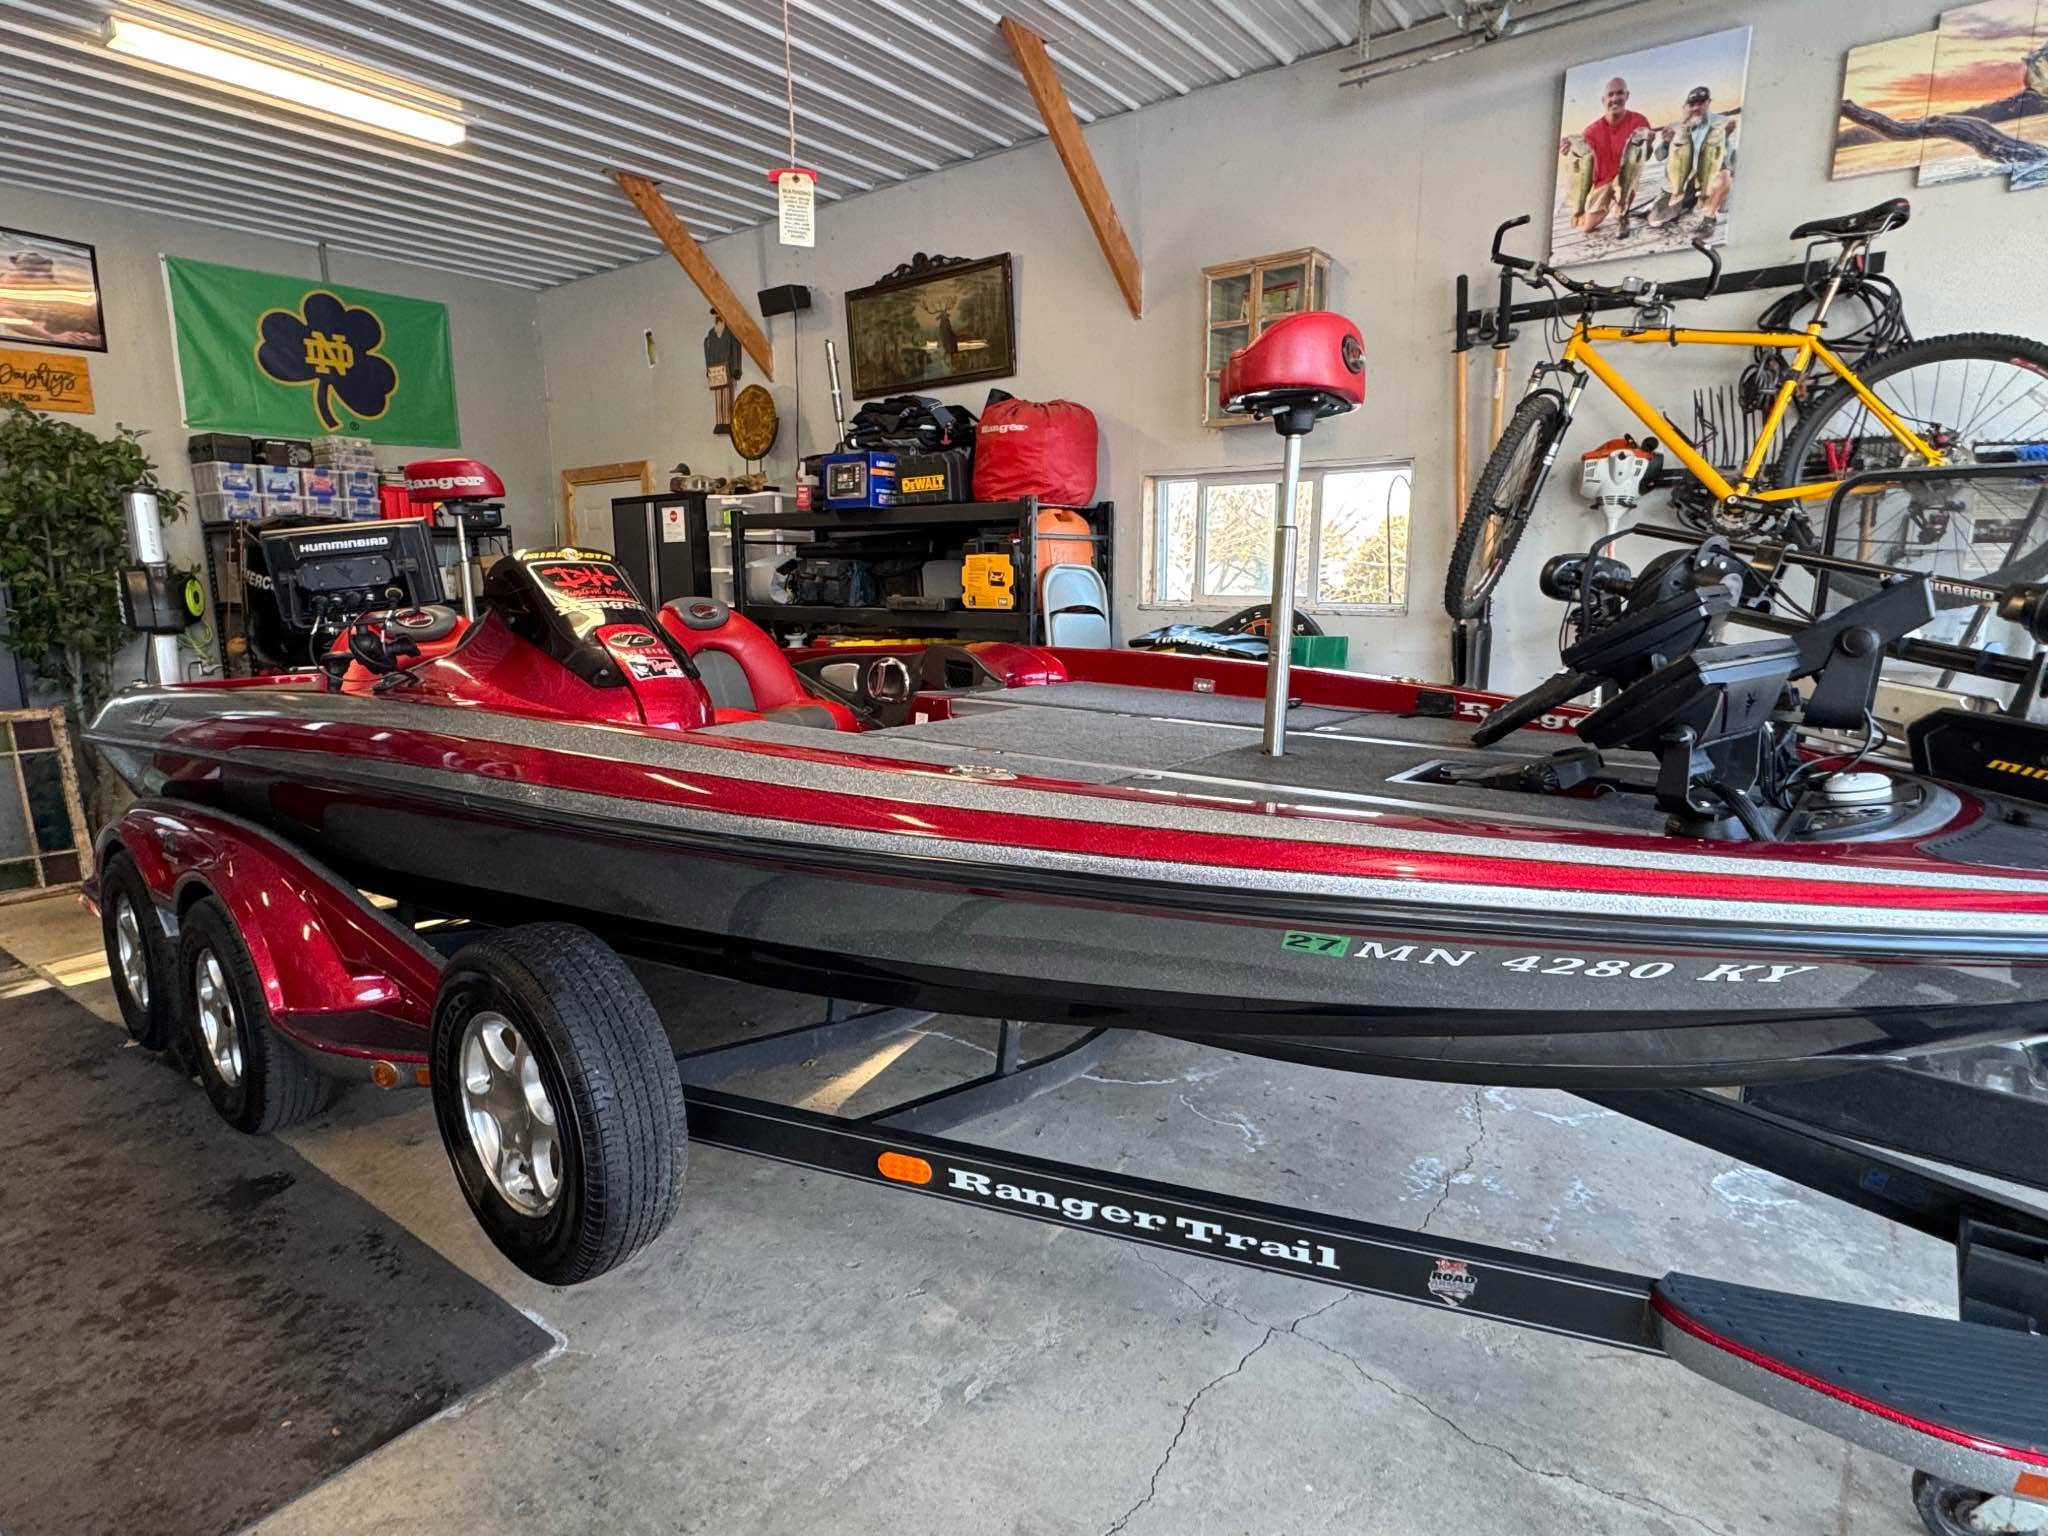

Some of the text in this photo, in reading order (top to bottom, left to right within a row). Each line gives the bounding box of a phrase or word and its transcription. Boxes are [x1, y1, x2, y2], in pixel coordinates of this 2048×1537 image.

[299, 536, 389, 554] HUMMINBIRD
[243, 567, 275, 592] MERC
[1286, 934, 1820, 983] 27 MN 4280 KY
[947, 1167, 1341, 1271] Ranger Trail
[1432, 1271, 1476, 1284] ROAD
